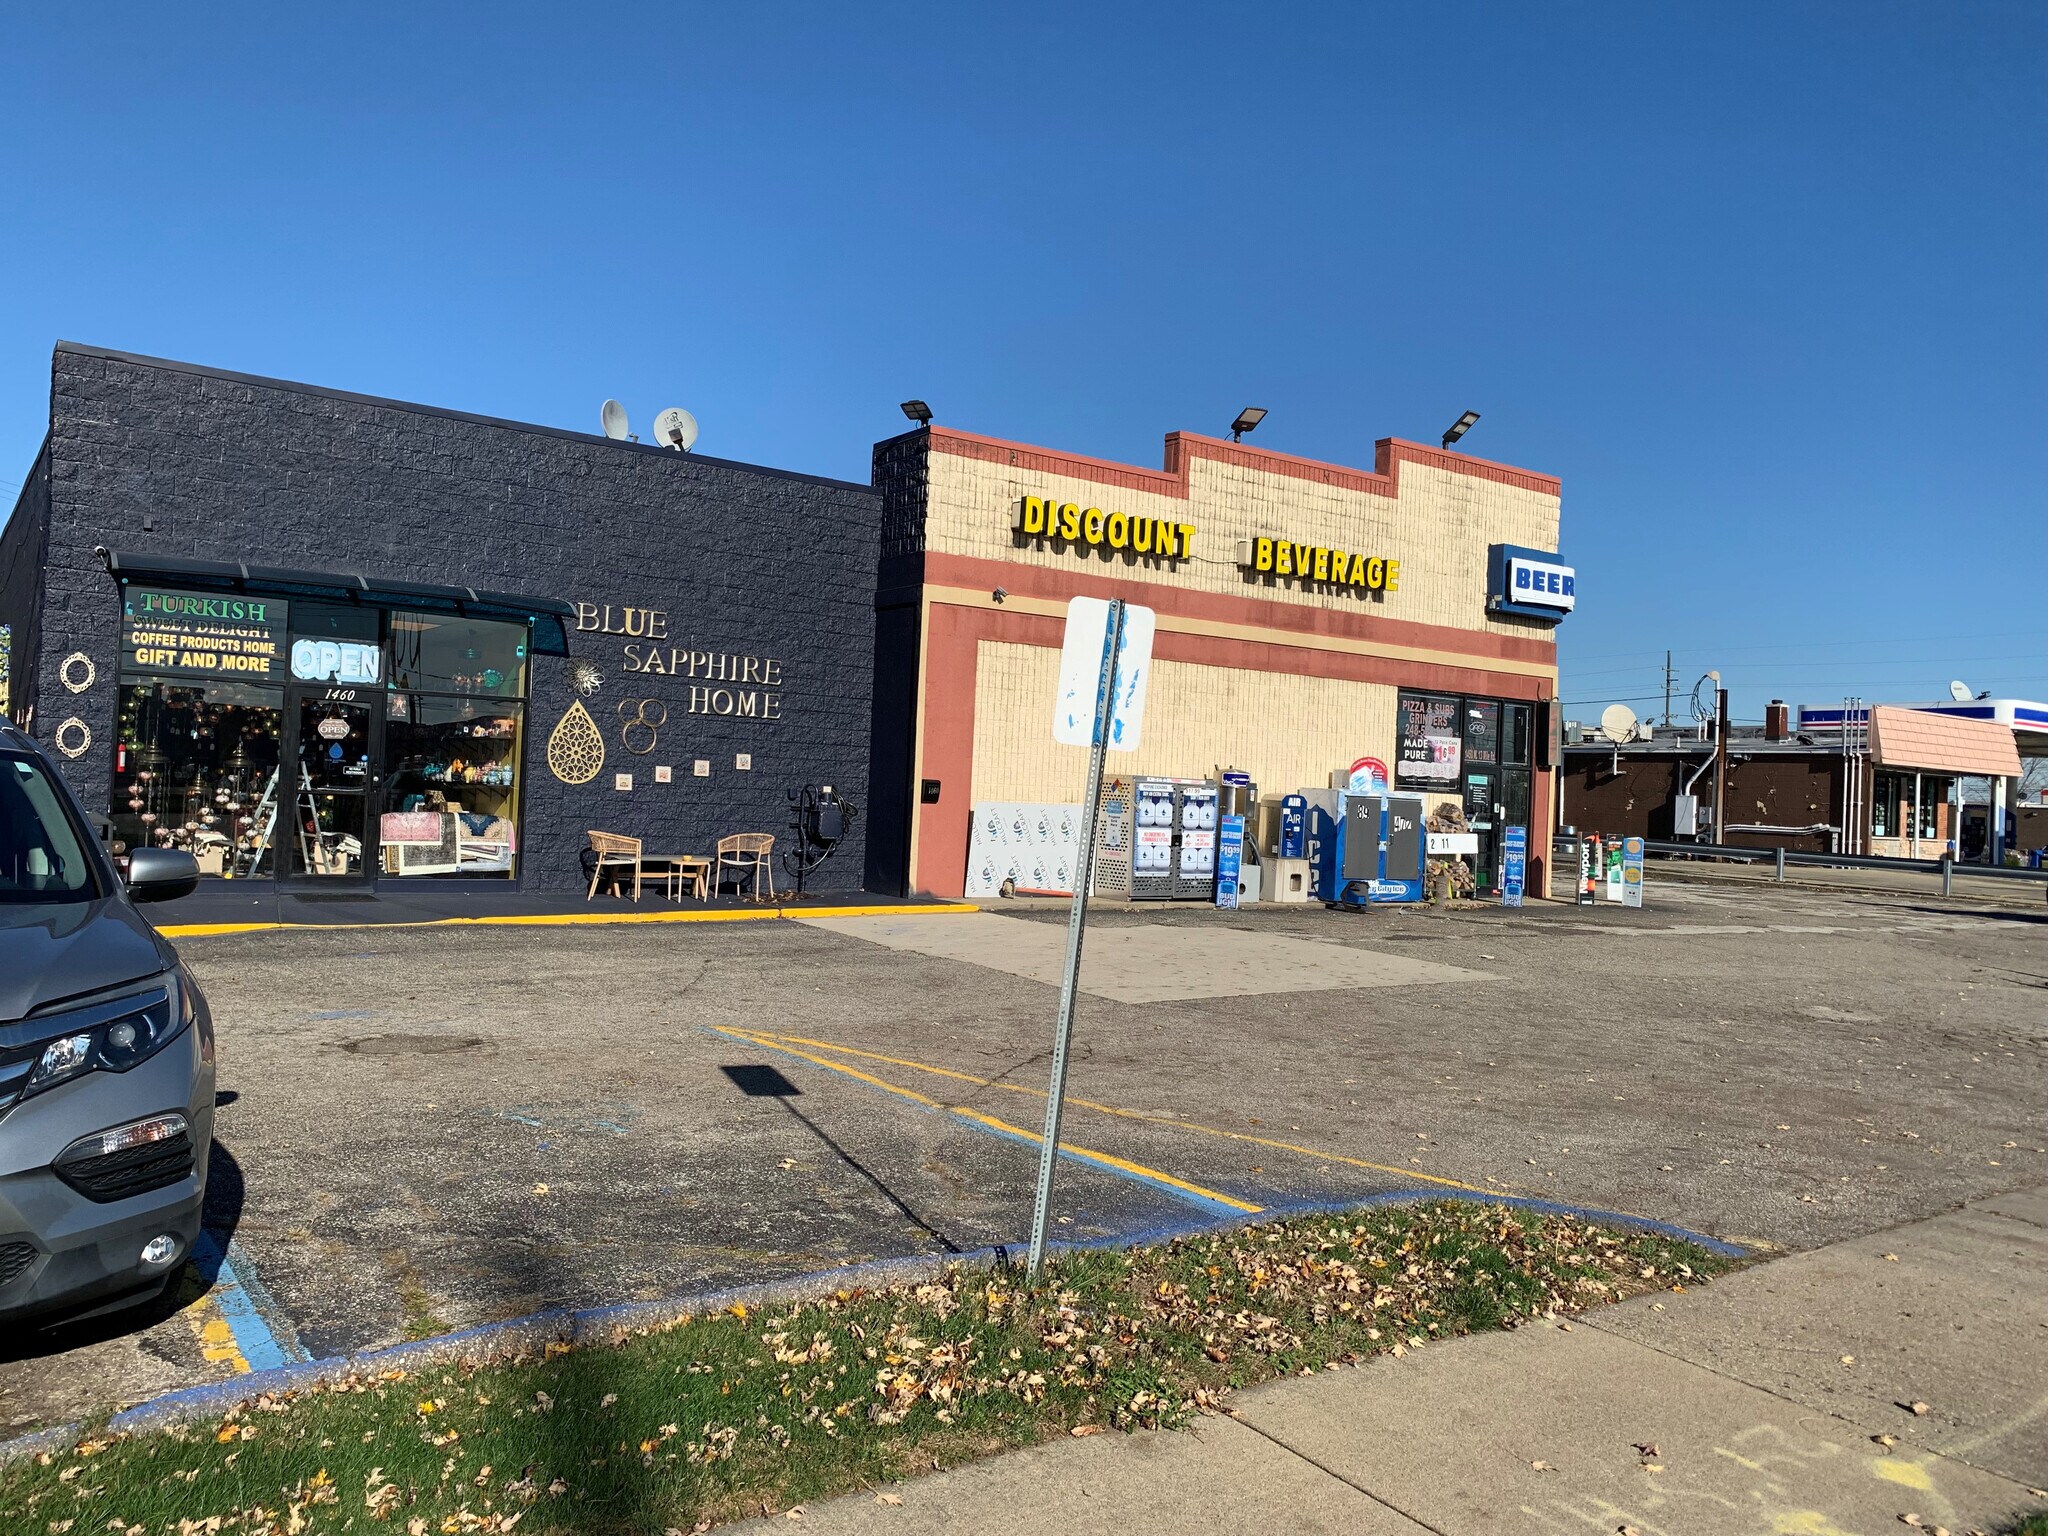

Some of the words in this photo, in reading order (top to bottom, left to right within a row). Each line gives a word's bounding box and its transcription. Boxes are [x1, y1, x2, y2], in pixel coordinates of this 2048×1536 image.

[1023, 495, 1196, 559] DISCOUNT
[1256, 537, 1400, 591] BEVERAGE
[1516, 567, 1575, 597] BEER
[140, 592, 267, 622] TURKISH
[576, 602, 668, 639] BLUE
[133, 615, 193, 633] SWEET
[195, 620, 272, 639] DELIGHT
[131, 631, 177, 647] COFFEE
[179, 635, 241, 652] PRODUCTS
[243, 640, 276, 654] HOME
[135, 647, 177, 666] GIFT
[180, 652, 217, 668] AND
[221, 654, 270, 672] MORE
[292, 640, 381, 683] OPEN
[623, 644, 782, 686] SAPPHIRE
[325, 689, 356, 701] 1460
[688, 685, 781, 719] HOME
[1402, 700, 1425, 713] PIZZA
[1427, 703, 1433, 714] &
[1435, 703, 1455, 716] SUBS
[320, 726, 348, 734] OPEN
[1403, 738, 1428, 749] MADE
[1404, 750, 1426, 760] PURE
[1288, 797, 1301, 807] AIR
[991, 807, 1008, 846] MILLCRAFT
[1015, 808, 1034, 847] MILLCRAFT
[1039, 808, 1057, 847] MILLCRAFT
[1062, 809, 1080, 847] MILLCRAFT
[1286, 813, 1301, 824] AIR
[972, 822, 983, 846] MILLC
[1430, 838, 1435, 849] 2
[1442, 838, 1449, 849] 11
[967, 870, 977, 893] MILLC
[1011, 855, 1028, 888] ILLCRAFT
[1579, 843, 1590, 894] Newport
